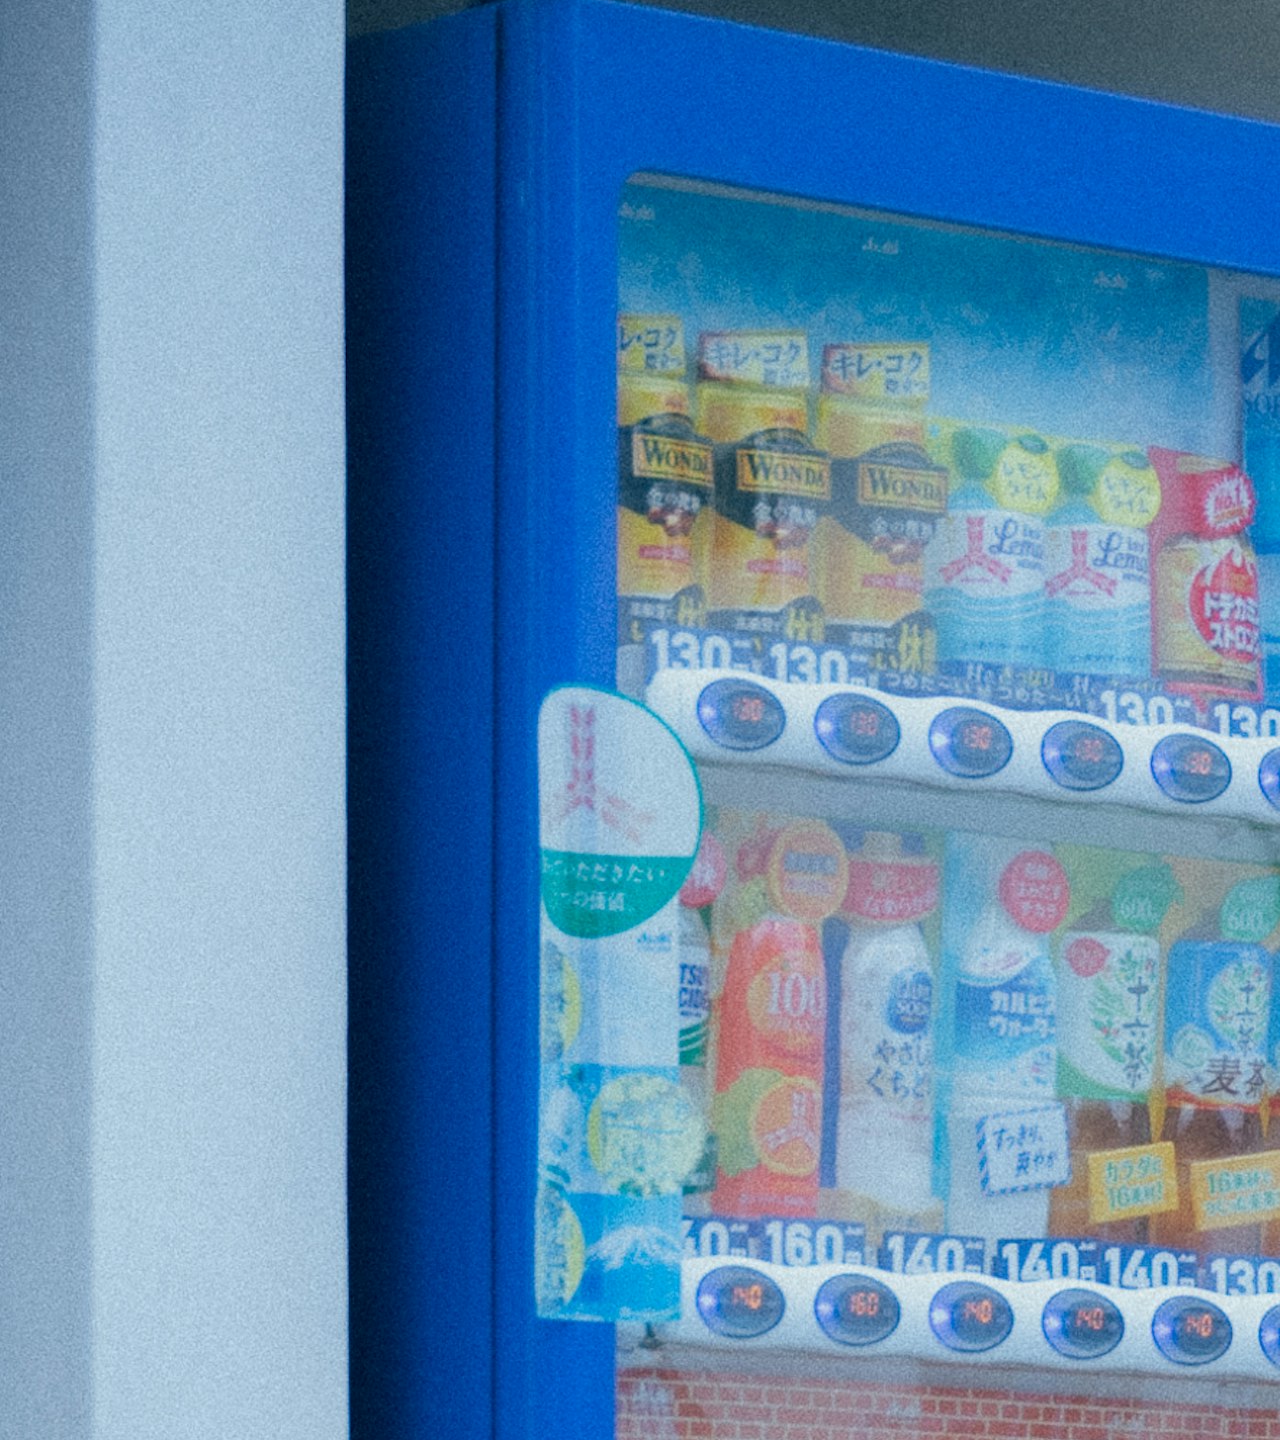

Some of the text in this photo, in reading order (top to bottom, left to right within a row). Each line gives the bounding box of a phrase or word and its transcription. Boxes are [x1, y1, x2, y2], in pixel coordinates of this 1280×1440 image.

[833, 351, 922, 378] キレ・コク
[651, 628, 751, 672] 130
[769, 641, 865, 684] 130
